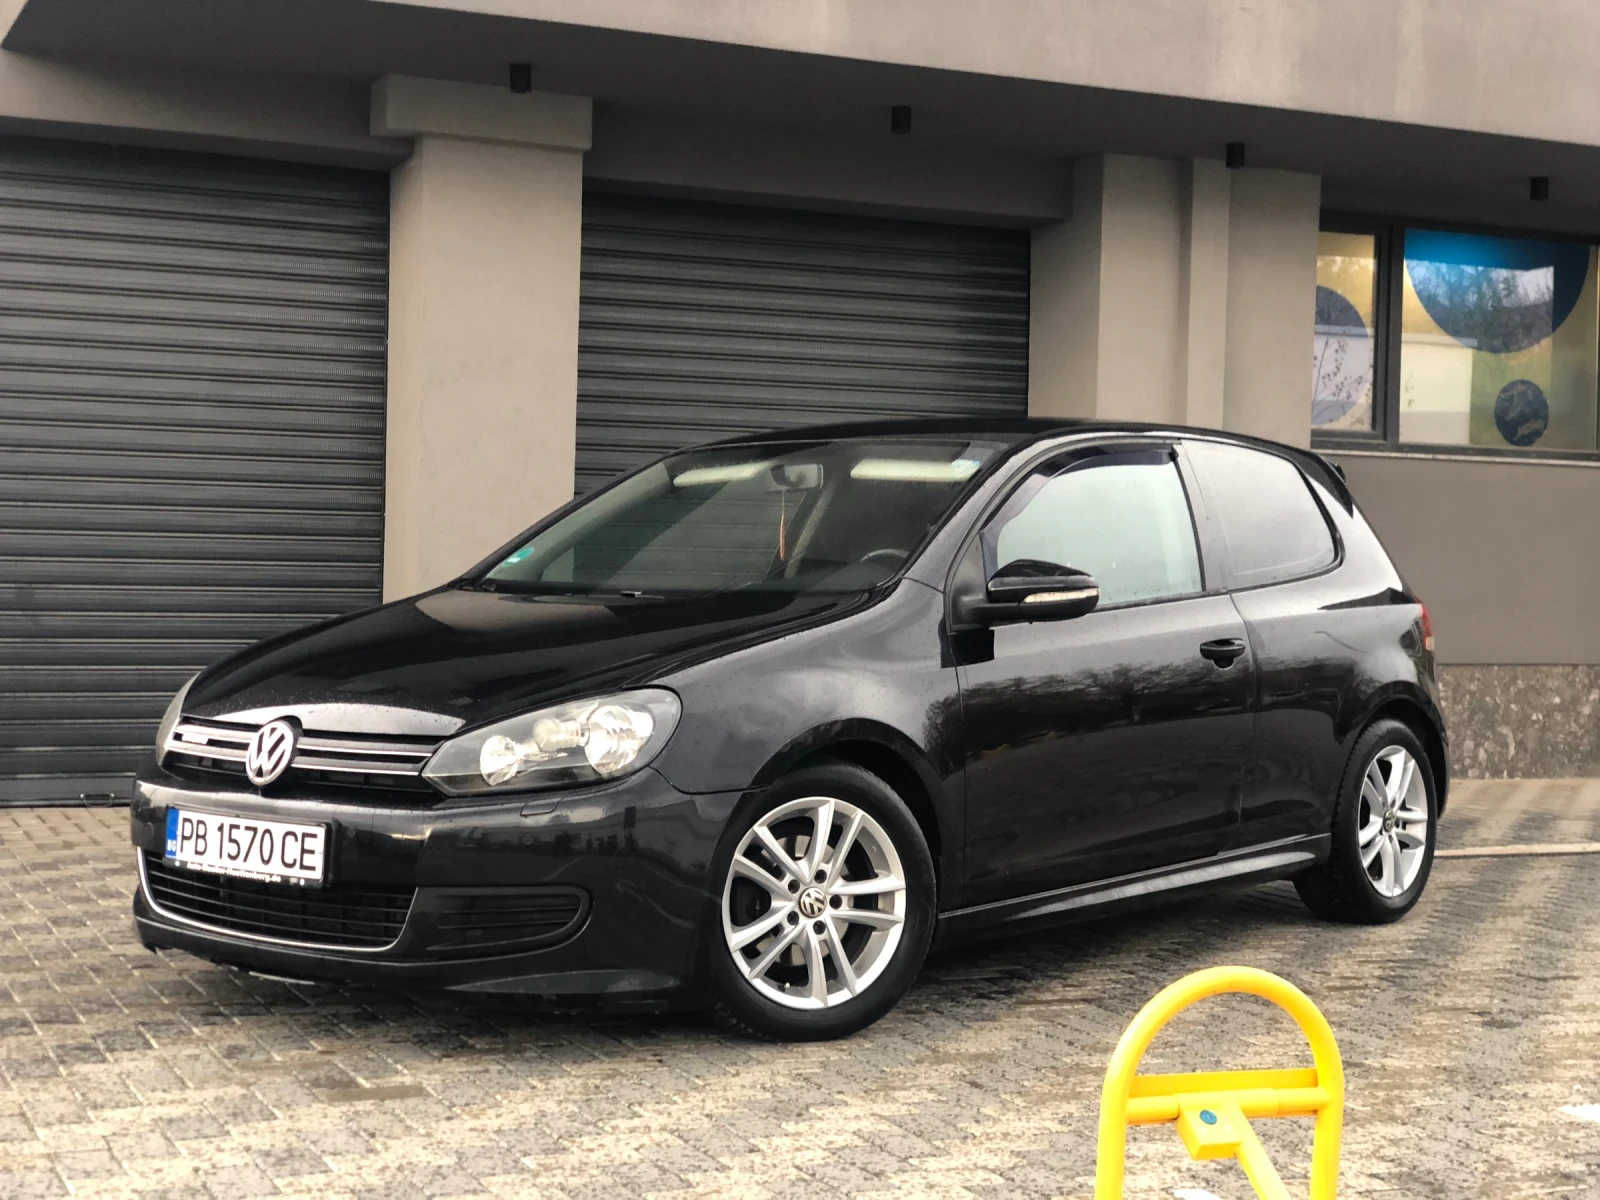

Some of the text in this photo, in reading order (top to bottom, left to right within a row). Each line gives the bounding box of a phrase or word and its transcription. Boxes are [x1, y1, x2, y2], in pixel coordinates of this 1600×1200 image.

[246, 721, 293, 785] VW
[167, 839, 177, 852] BG
[180, 817, 318, 872] PB 1570 CE
